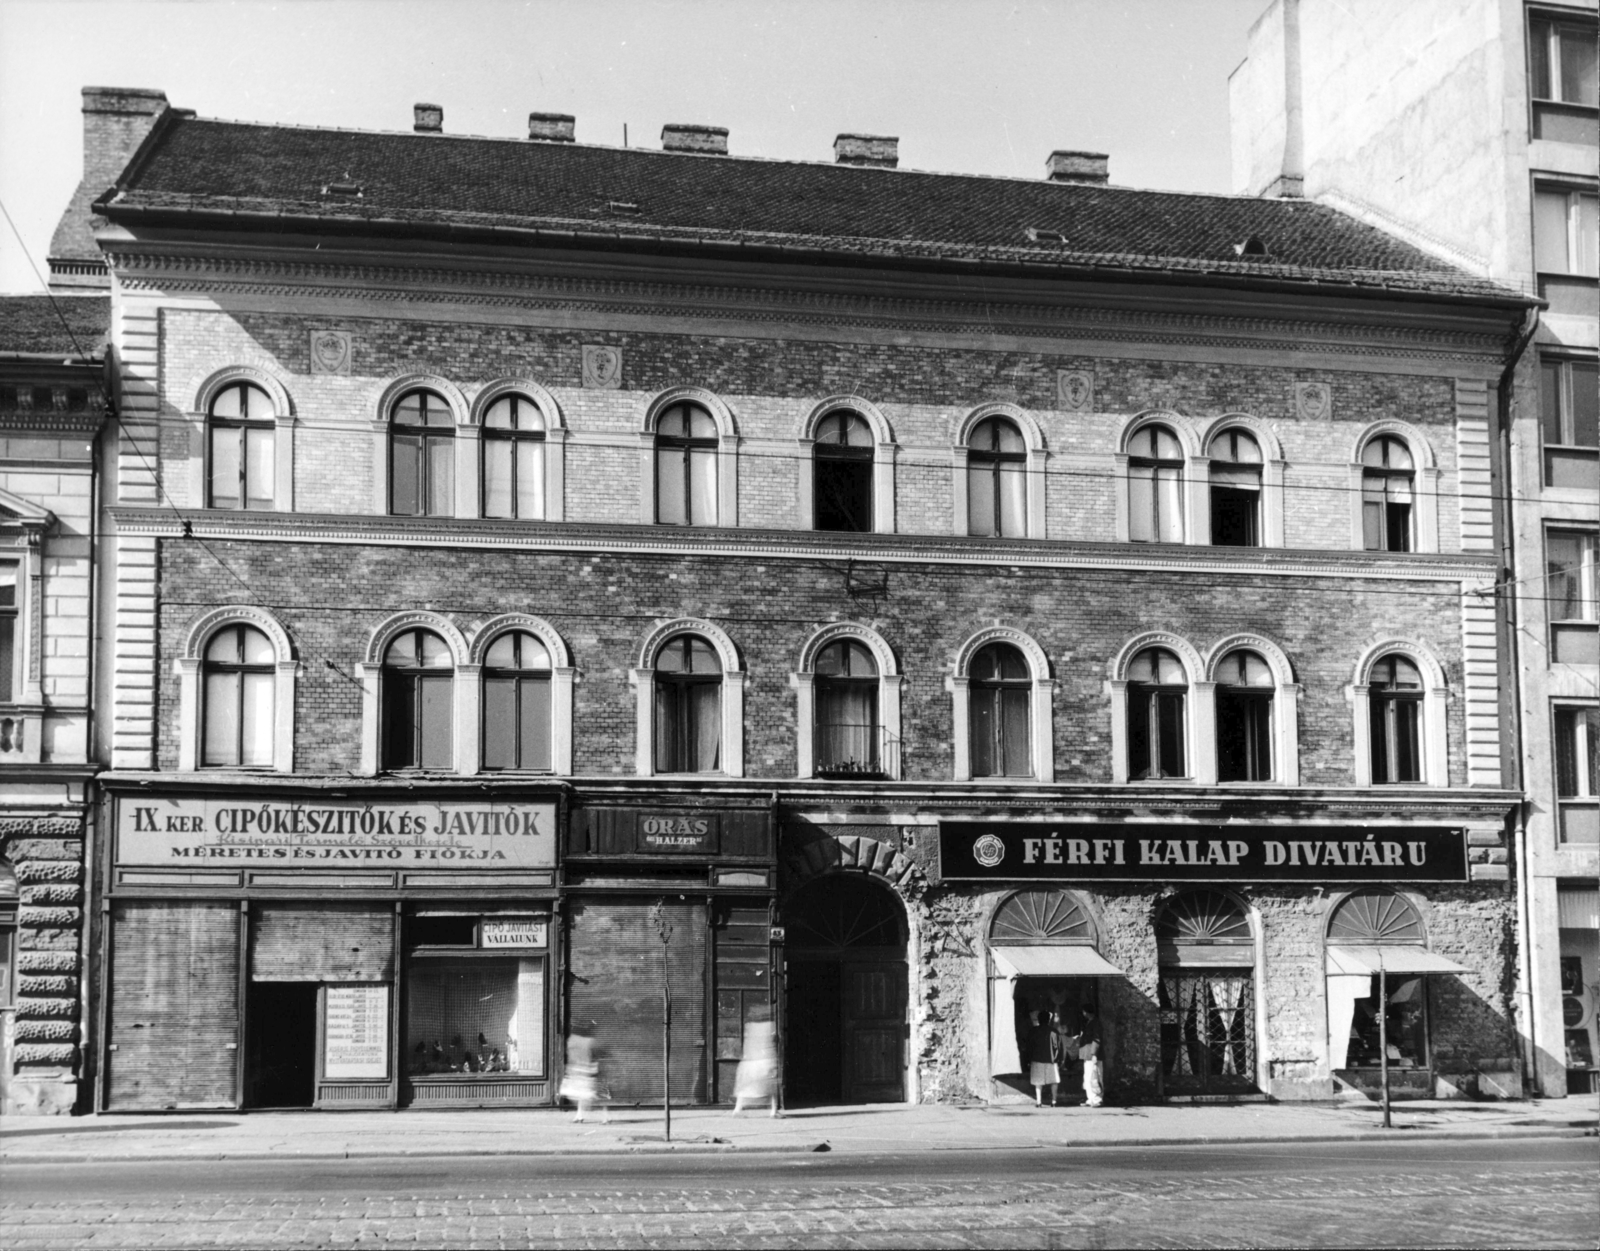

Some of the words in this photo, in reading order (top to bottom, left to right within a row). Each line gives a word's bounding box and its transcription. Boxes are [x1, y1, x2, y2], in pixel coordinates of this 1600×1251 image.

[134, 807, 162, 832] IX.
[215, 804, 395, 834] CIPŐKÉSZITŐK
[399, 811, 427, 835] ÉS
[433, 806, 540, 836] JAVITÓK
[643, 815, 708, 835] ÓRÁS
[171, 846, 288, 859] MÉRETES
[293, 847, 315, 859] ÉS
[319, 846, 402, 860] JAVITÓ
[414, 847, 506, 860] FIÓKJA
[1023, 832, 1126, 865] FÉRFI
[1139, 840, 1249, 866] KALAP
[1263, 833, 1427, 867] DIVATÁRU
